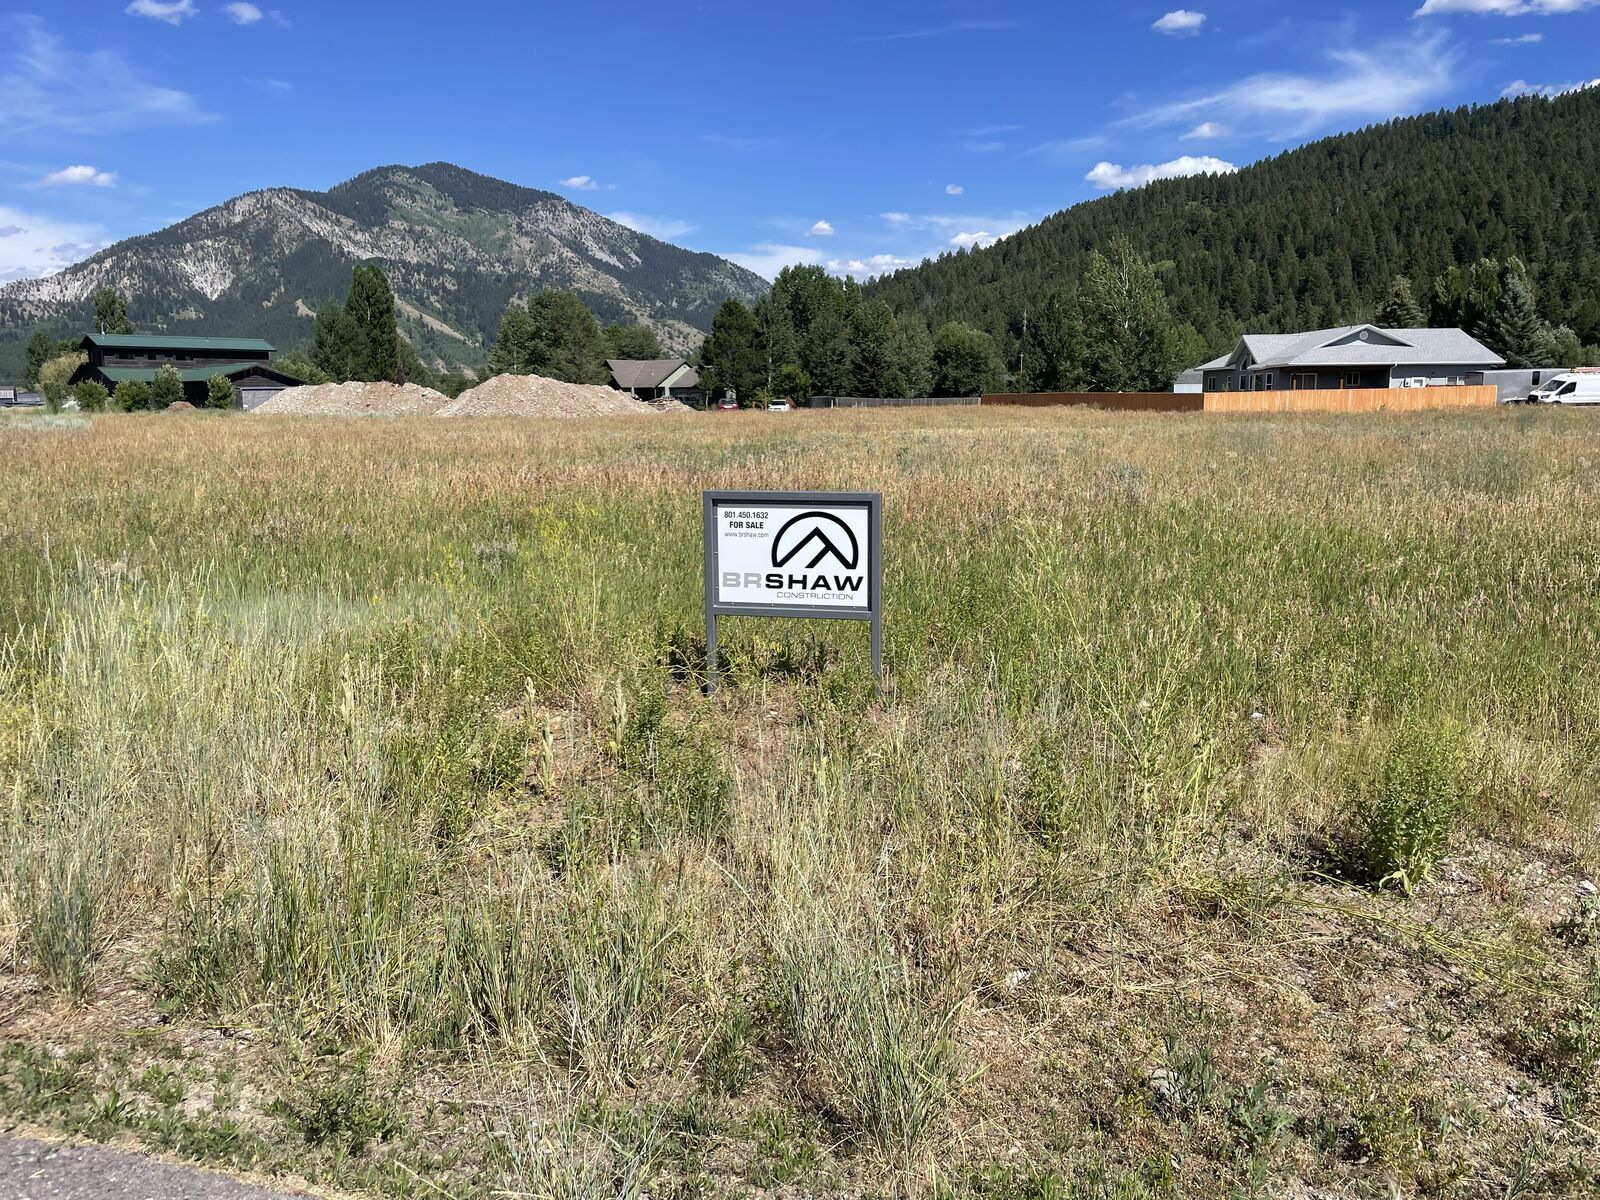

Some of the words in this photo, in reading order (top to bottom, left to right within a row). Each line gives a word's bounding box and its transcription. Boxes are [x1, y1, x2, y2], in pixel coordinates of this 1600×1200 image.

[724, 511, 769, 519] 801.450.1632
[729, 521, 744, 529] FOR
[776, 591, 854, 600] CONSTRUCTION
